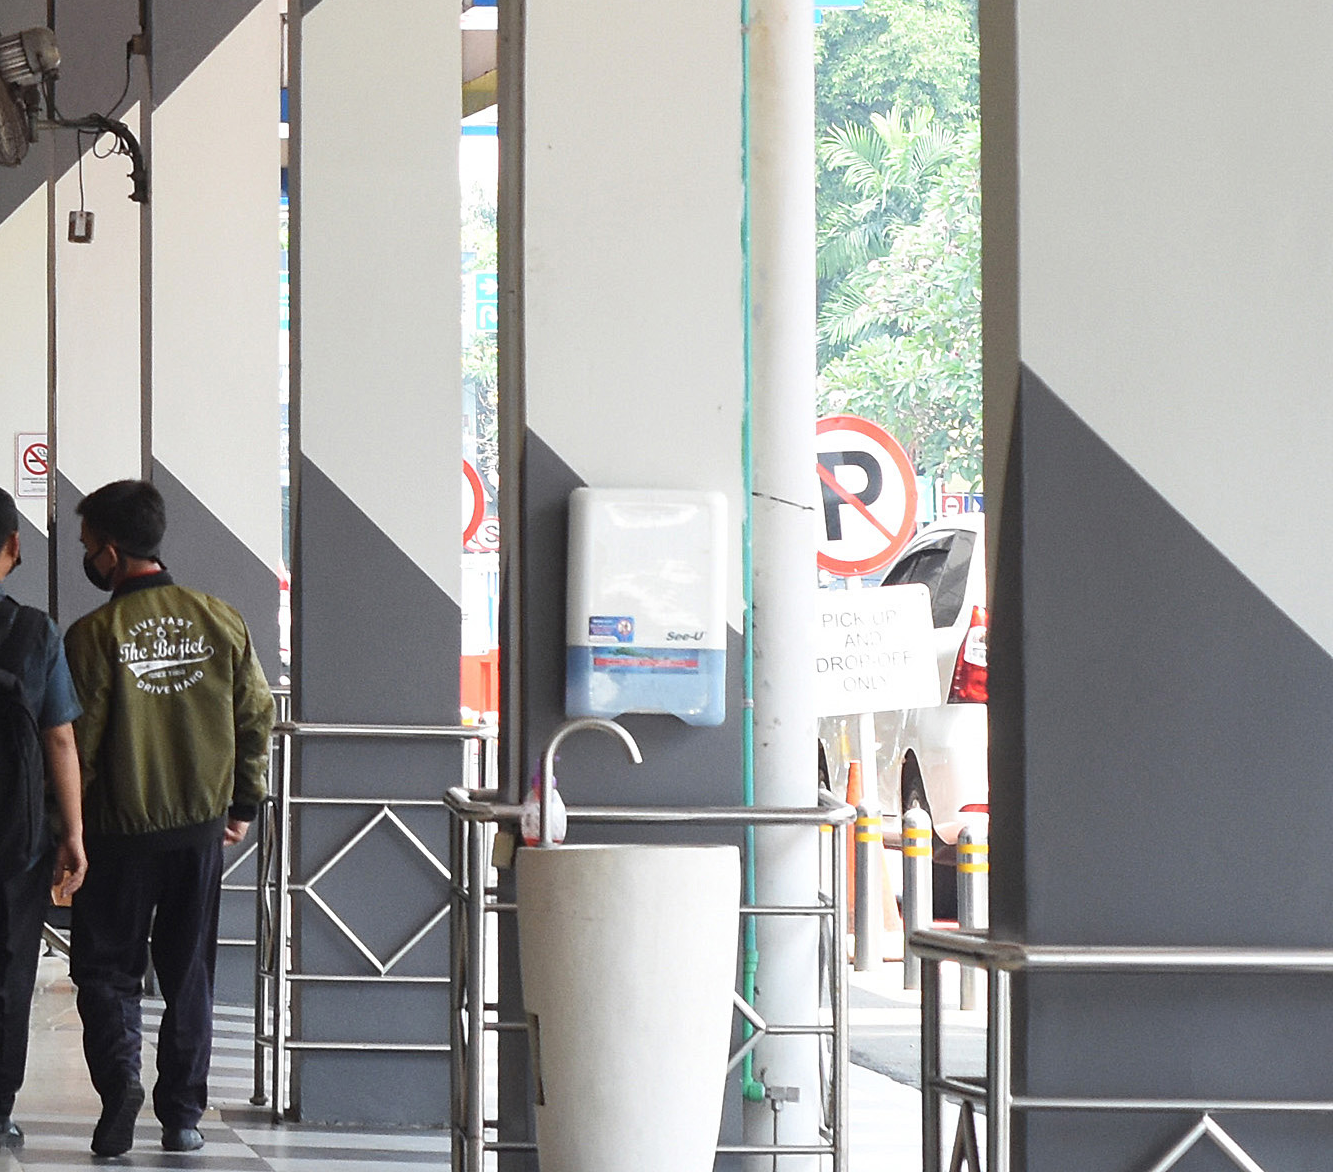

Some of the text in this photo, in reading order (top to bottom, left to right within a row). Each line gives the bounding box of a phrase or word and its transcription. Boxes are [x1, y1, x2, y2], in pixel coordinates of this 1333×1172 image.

[816, 450, 883, 541] P
[128, 616, 194, 637] LIVE FAST
[665, 631, 705, 642] See-U
[119, 641, 149, 663] The
[136, 679, 171, 695] DRIVE
[173, 669, 205, 693] HARD
